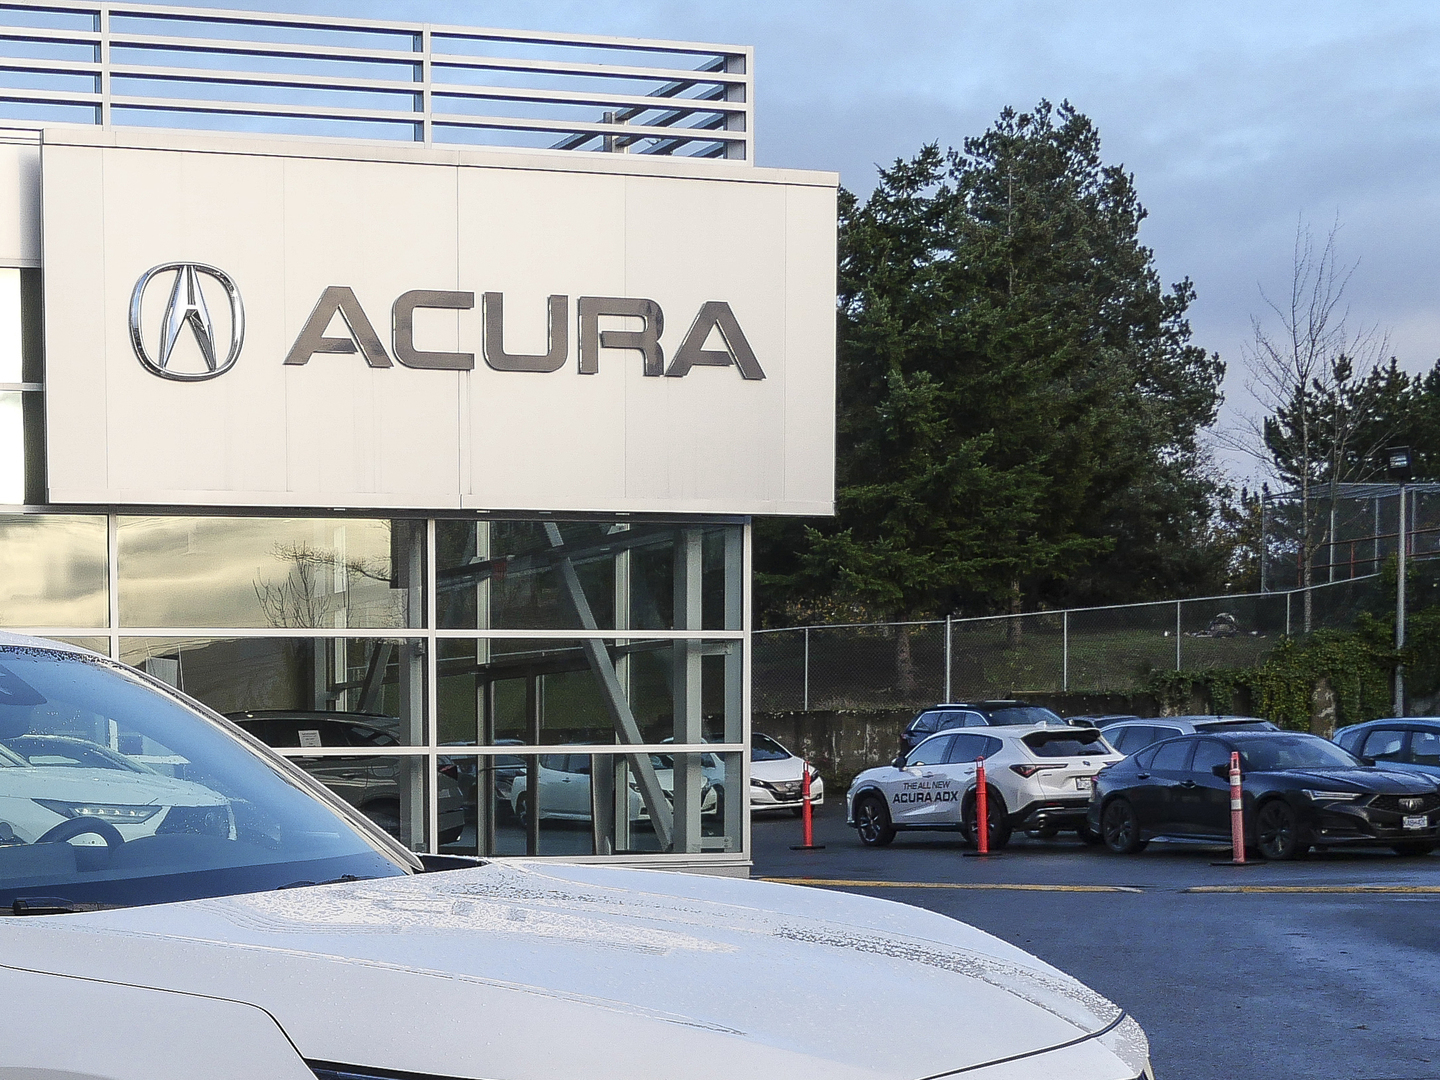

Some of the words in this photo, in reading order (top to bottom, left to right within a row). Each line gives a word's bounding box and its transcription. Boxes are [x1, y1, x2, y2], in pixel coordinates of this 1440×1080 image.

[283, 285, 767, 381] ACURA
[918, 782, 931, 790] ALL
[932, 780, 951, 789] NEW
[893, 792, 933, 804] ACURA
[935, 791, 959, 802] ADX
